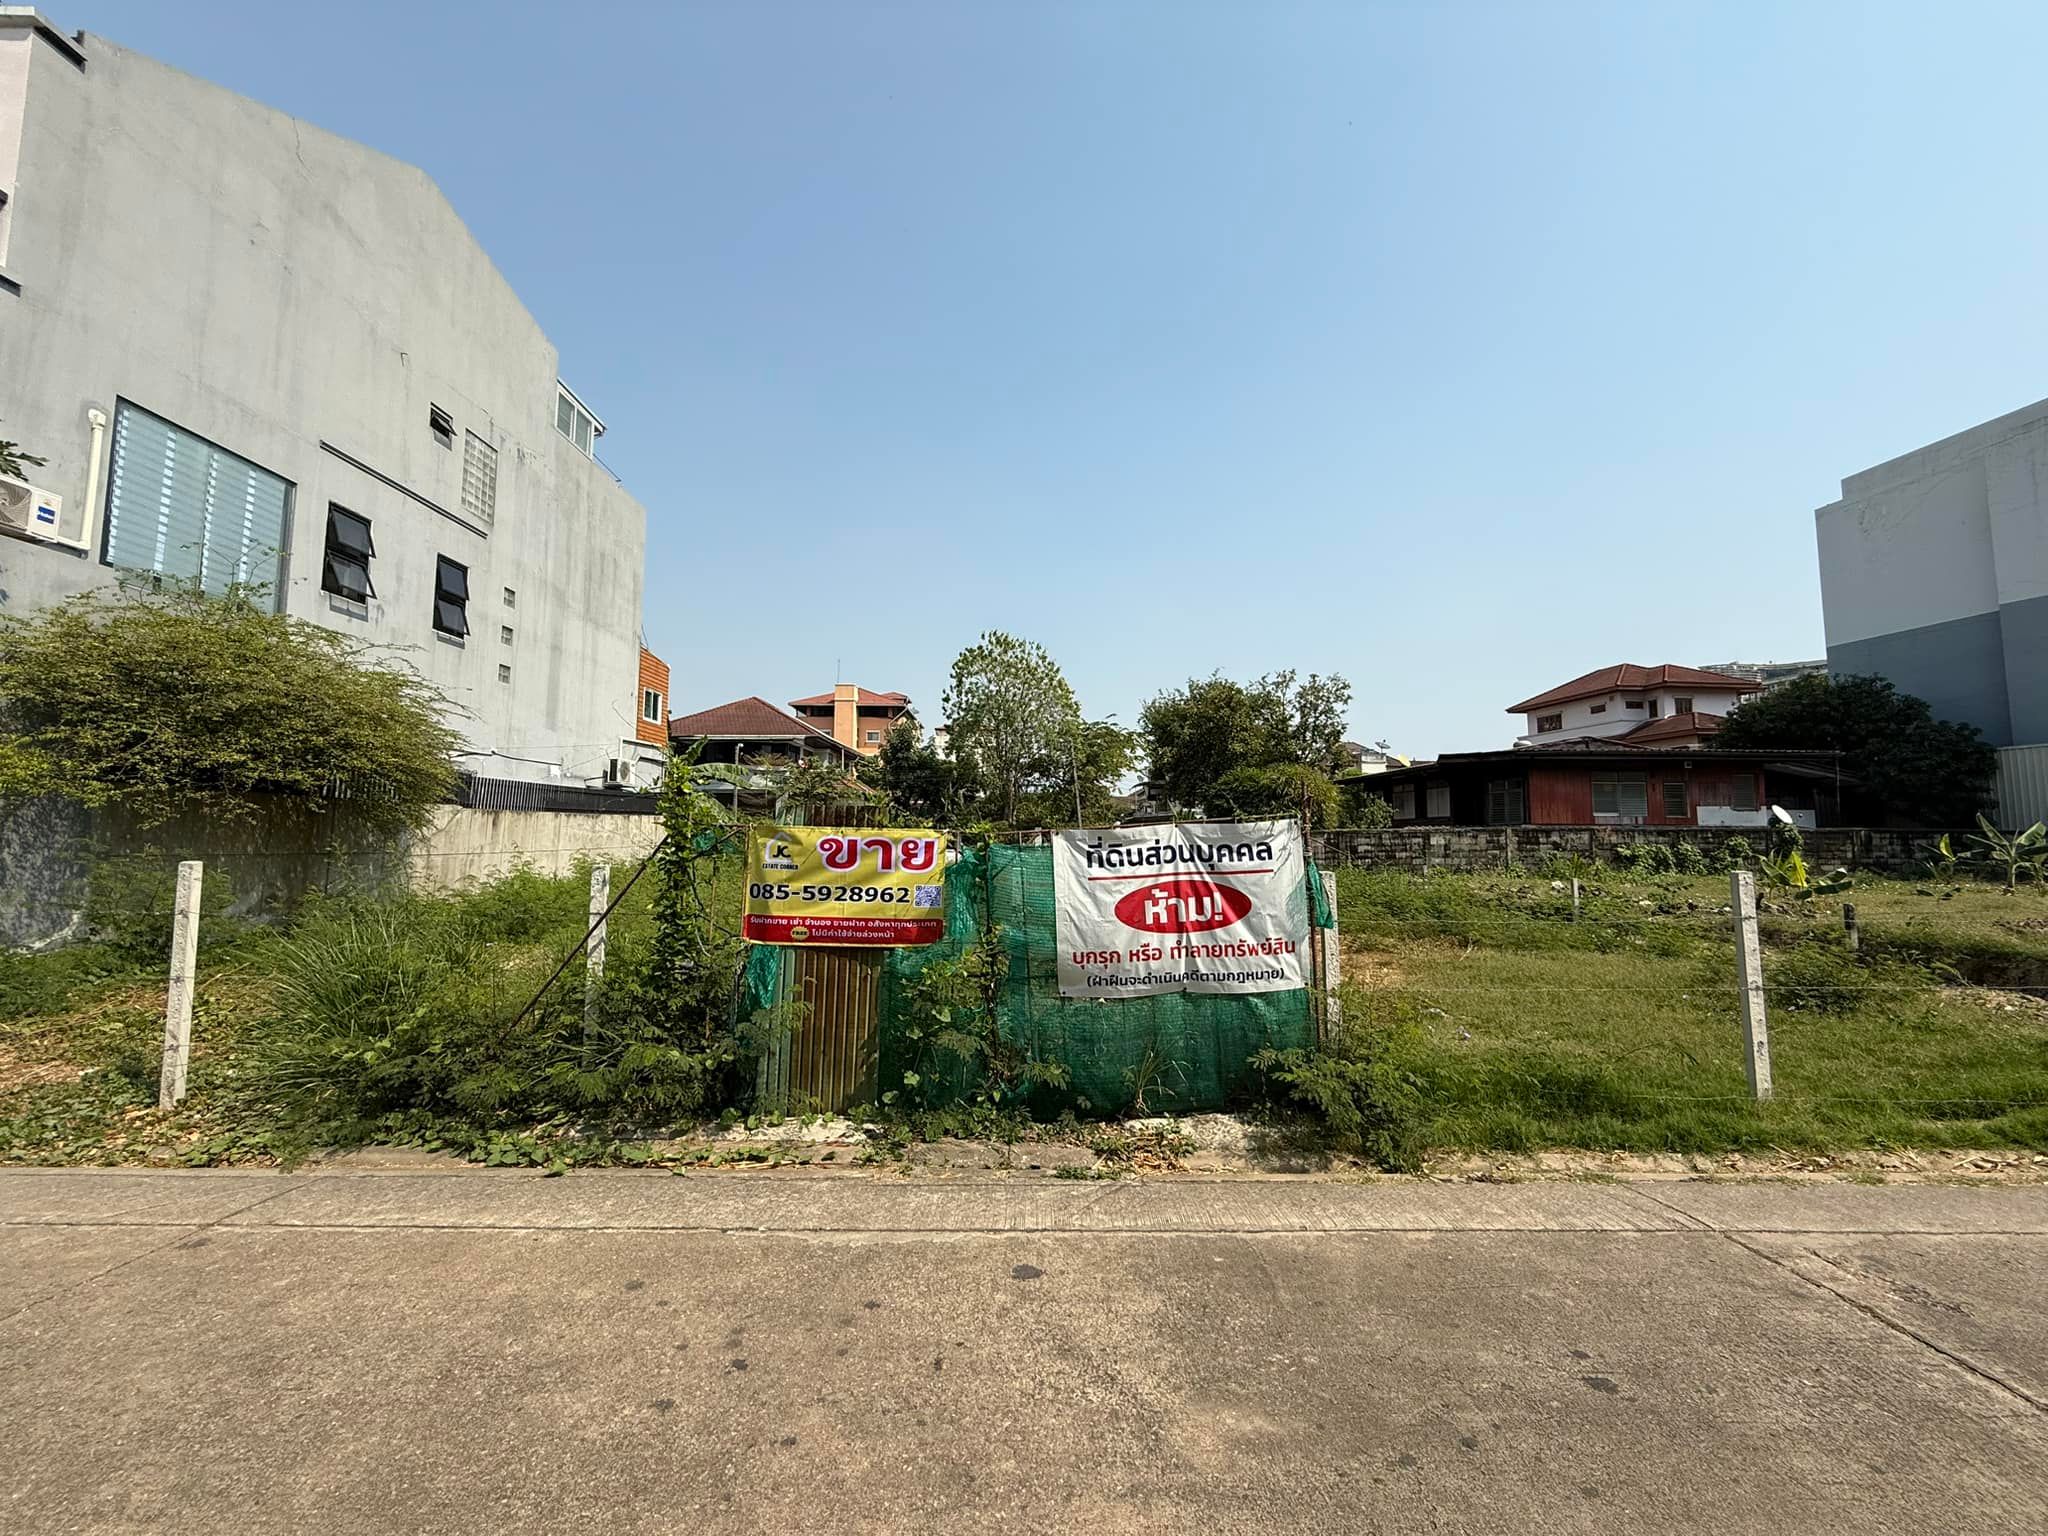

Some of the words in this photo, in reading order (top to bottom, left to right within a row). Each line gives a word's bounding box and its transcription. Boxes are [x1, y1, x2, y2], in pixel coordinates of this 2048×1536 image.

[772, 845, 791, 858] JC
[820, 837, 936, 872] ขาย
[1087, 836, 1273, 870] ที่ดินส่วนบุคคล
[750, 883, 910, 903] 085-5928962
[1144, 888, 1224, 925] ห้าม!
[1072, 949, 1121, 967] บุกรุก
[1129, 942, 1162, 963] หรือ
[1170, 937, 1296, 960] ทำลายทรัพย์สิน
[1087, 967, 1285, 988] (ฝ่าฝืนจะดำเนินคดีตามกฎหมาย)
